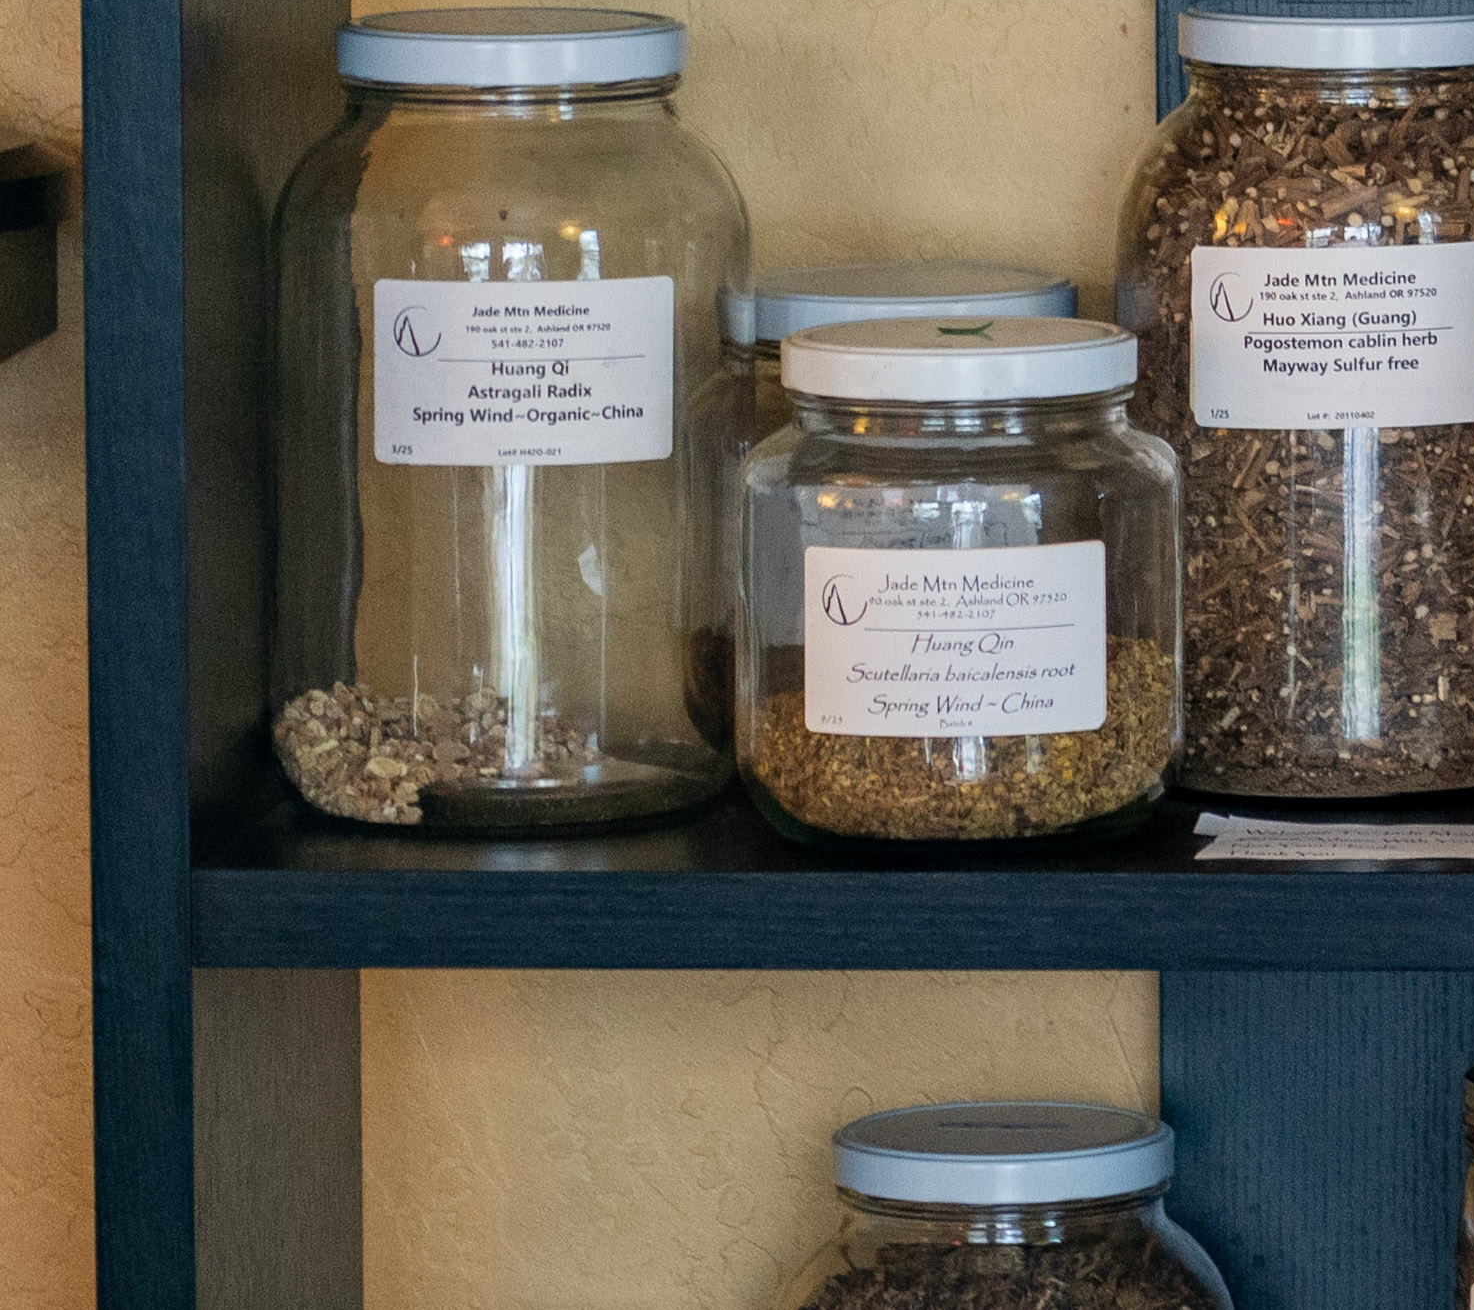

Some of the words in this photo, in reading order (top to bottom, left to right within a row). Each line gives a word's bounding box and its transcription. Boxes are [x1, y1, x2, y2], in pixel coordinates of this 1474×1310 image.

[1263, 313, 1295, 326] Huo
[1301, 313, 1346, 329] Xiang
[1353, 310, 1418, 330] (Guang)
[492, 361, 545, 379] Huang
[552, 361, 569, 376] Qi
[468, 385, 541, 401] Astragali
[548, 384, 591, 397] Radix
[911, 634, 974, 656] Huang
[978, 633, 1014, 654] Qin
